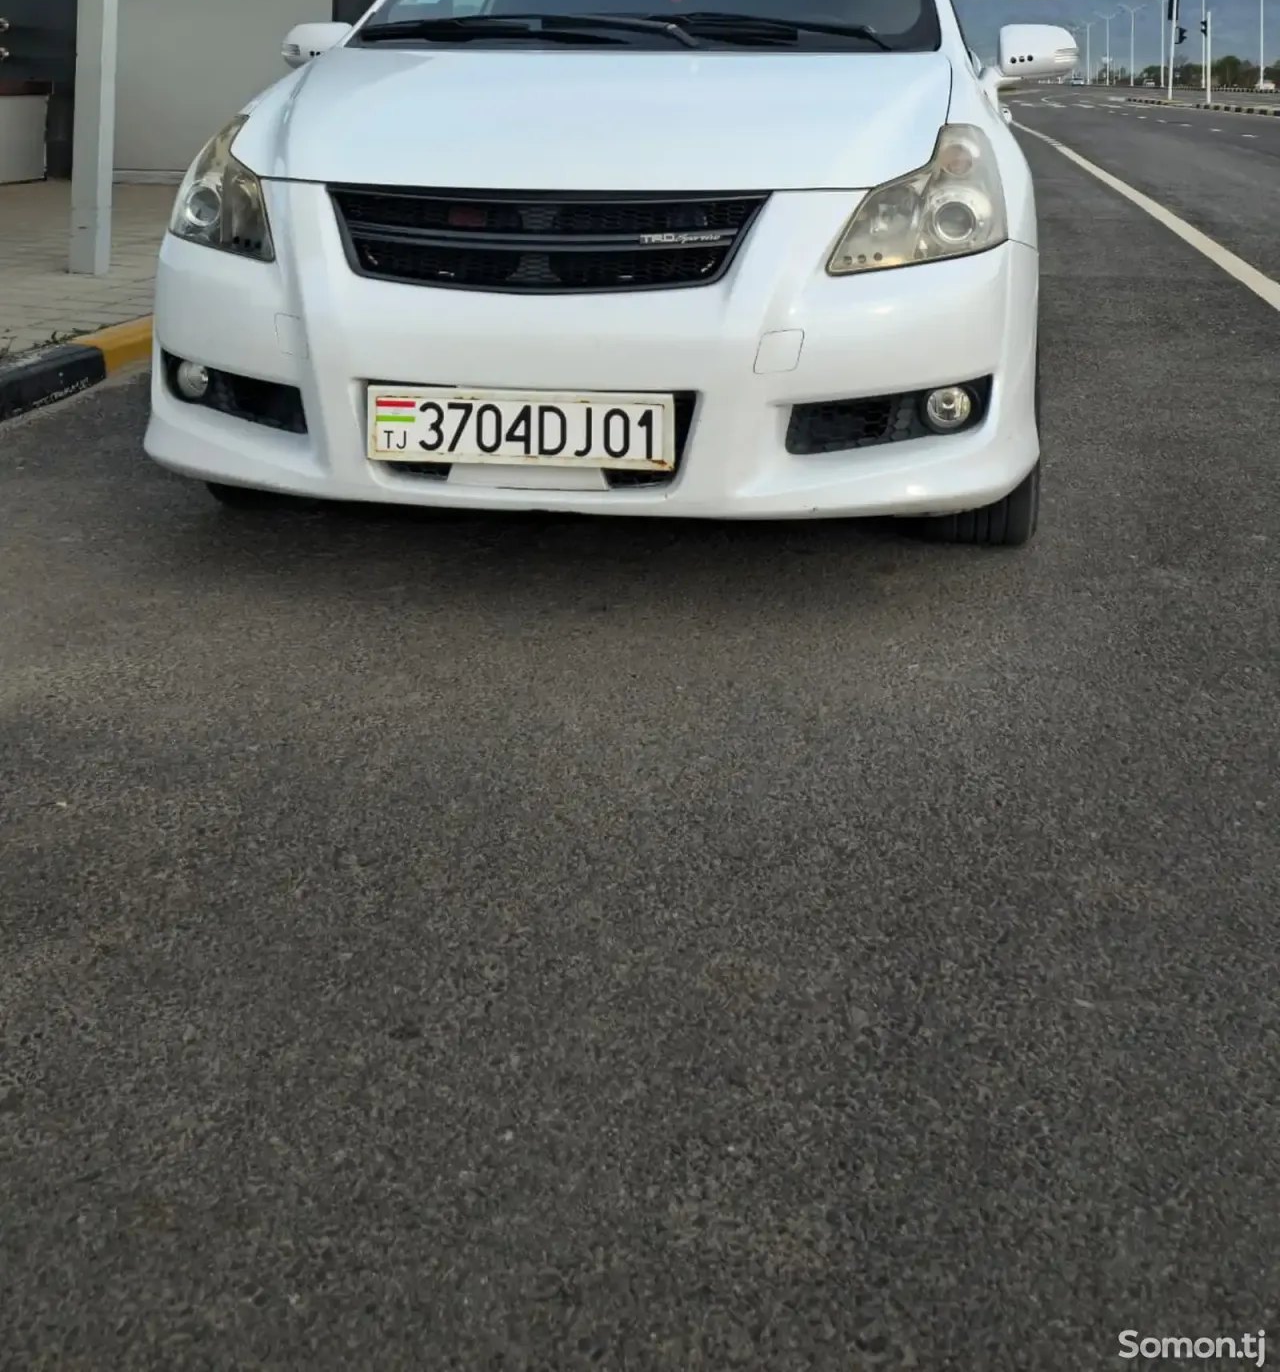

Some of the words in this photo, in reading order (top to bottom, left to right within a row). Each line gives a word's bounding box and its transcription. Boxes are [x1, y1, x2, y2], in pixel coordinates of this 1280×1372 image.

[640, 233, 675, 244] TRD
[383, 430, 407, 449] TJ
[418, 401, 654, 460] 3704DJ01
